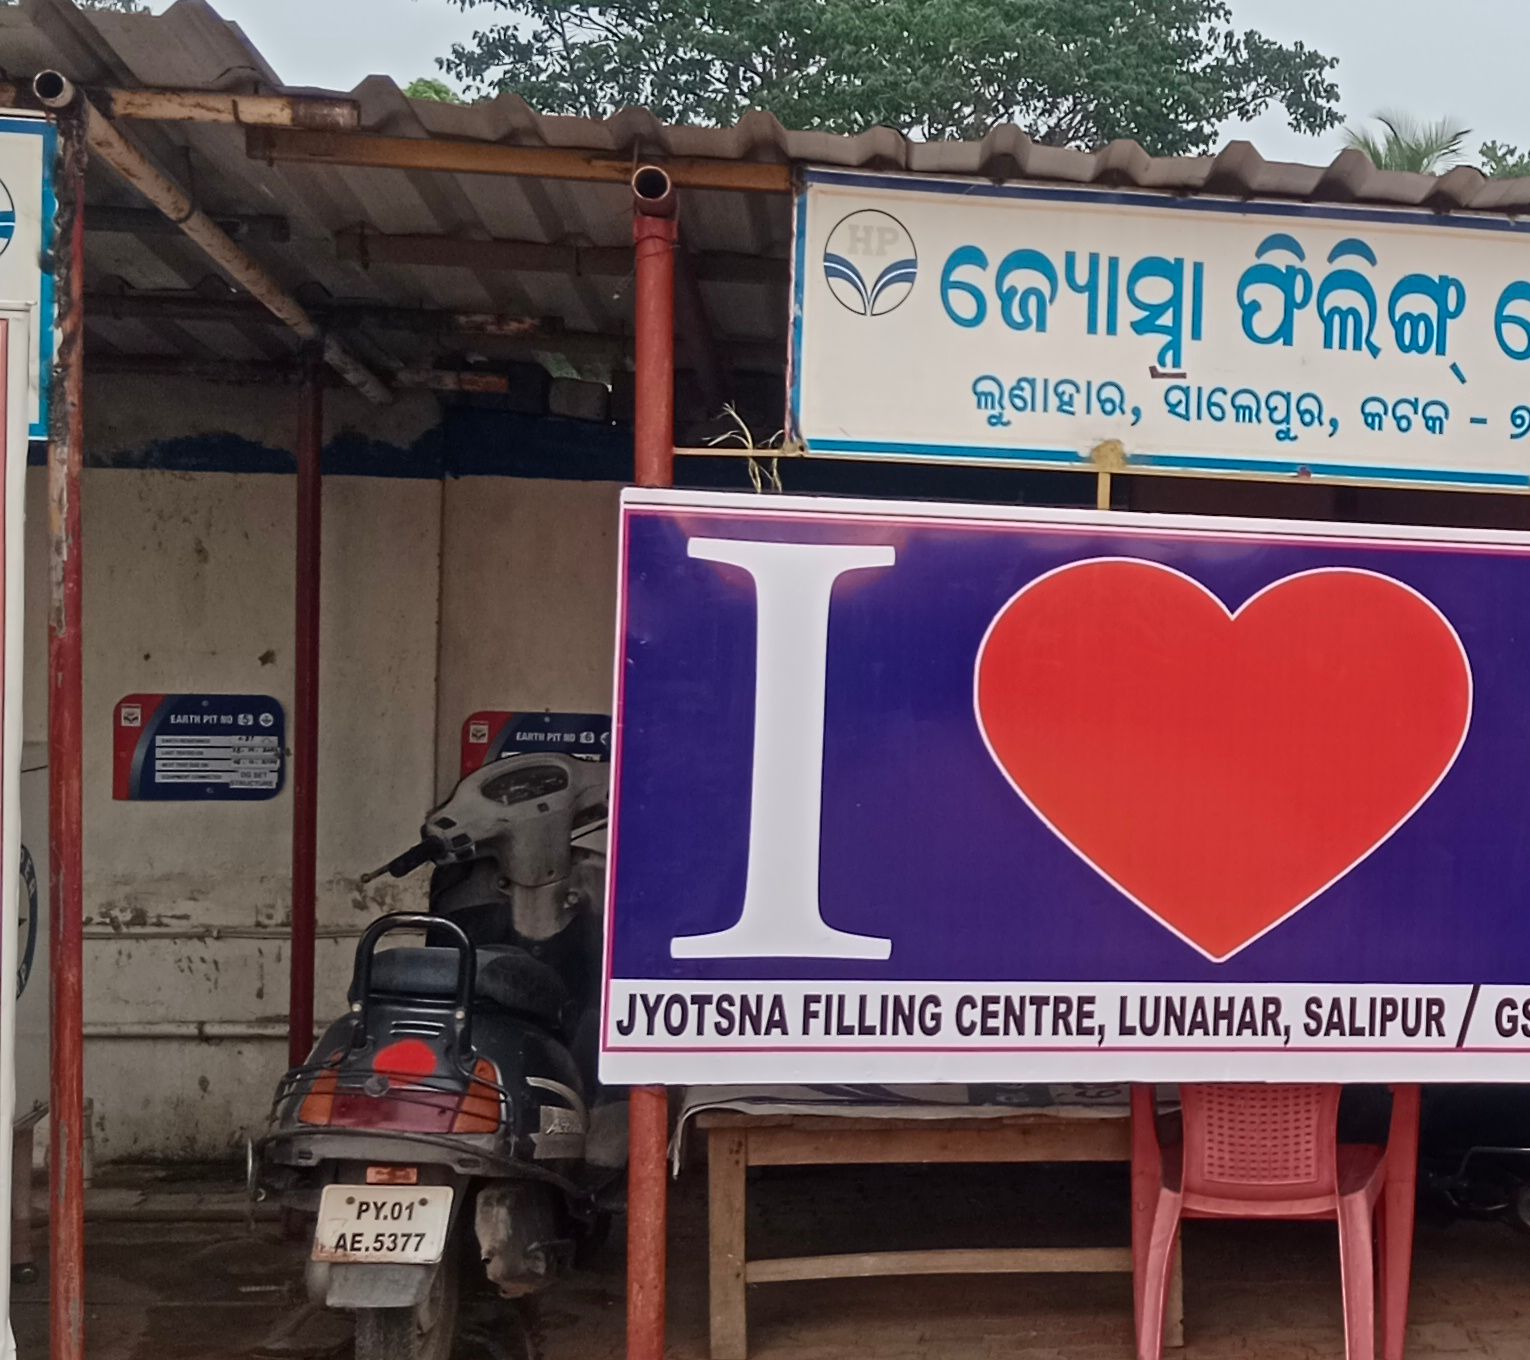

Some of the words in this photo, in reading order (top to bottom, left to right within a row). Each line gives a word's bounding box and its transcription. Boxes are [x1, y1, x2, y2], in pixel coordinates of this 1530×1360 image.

[847, 223, 899, 257] HP
[1361, 396, 1449, 435] କଟକ
[170, 714, 201, 724] EARTH
[203, 714, 217, 724] PIT
[220, 714, 233, 724] NO
[516, 731, 544, 741] EARTH
[546, 732, 561, 741] PIT
[563, 732, 576, 742] NO
[671, 537, 895, 960] I
[616, 994, 789, 1037] JYOTSNA
[801, 994, 942, 1036] FILLING
[955, 995, 1106, 1046] CENTRE,
[1119, 996, 1292, 1046] LUNAHAR,
[1303, 996, 1446, 1037] SALIPUR
[356, 1200, 416, 1221] PY.01
[333, 1232, 426, 1253] AE.5377
